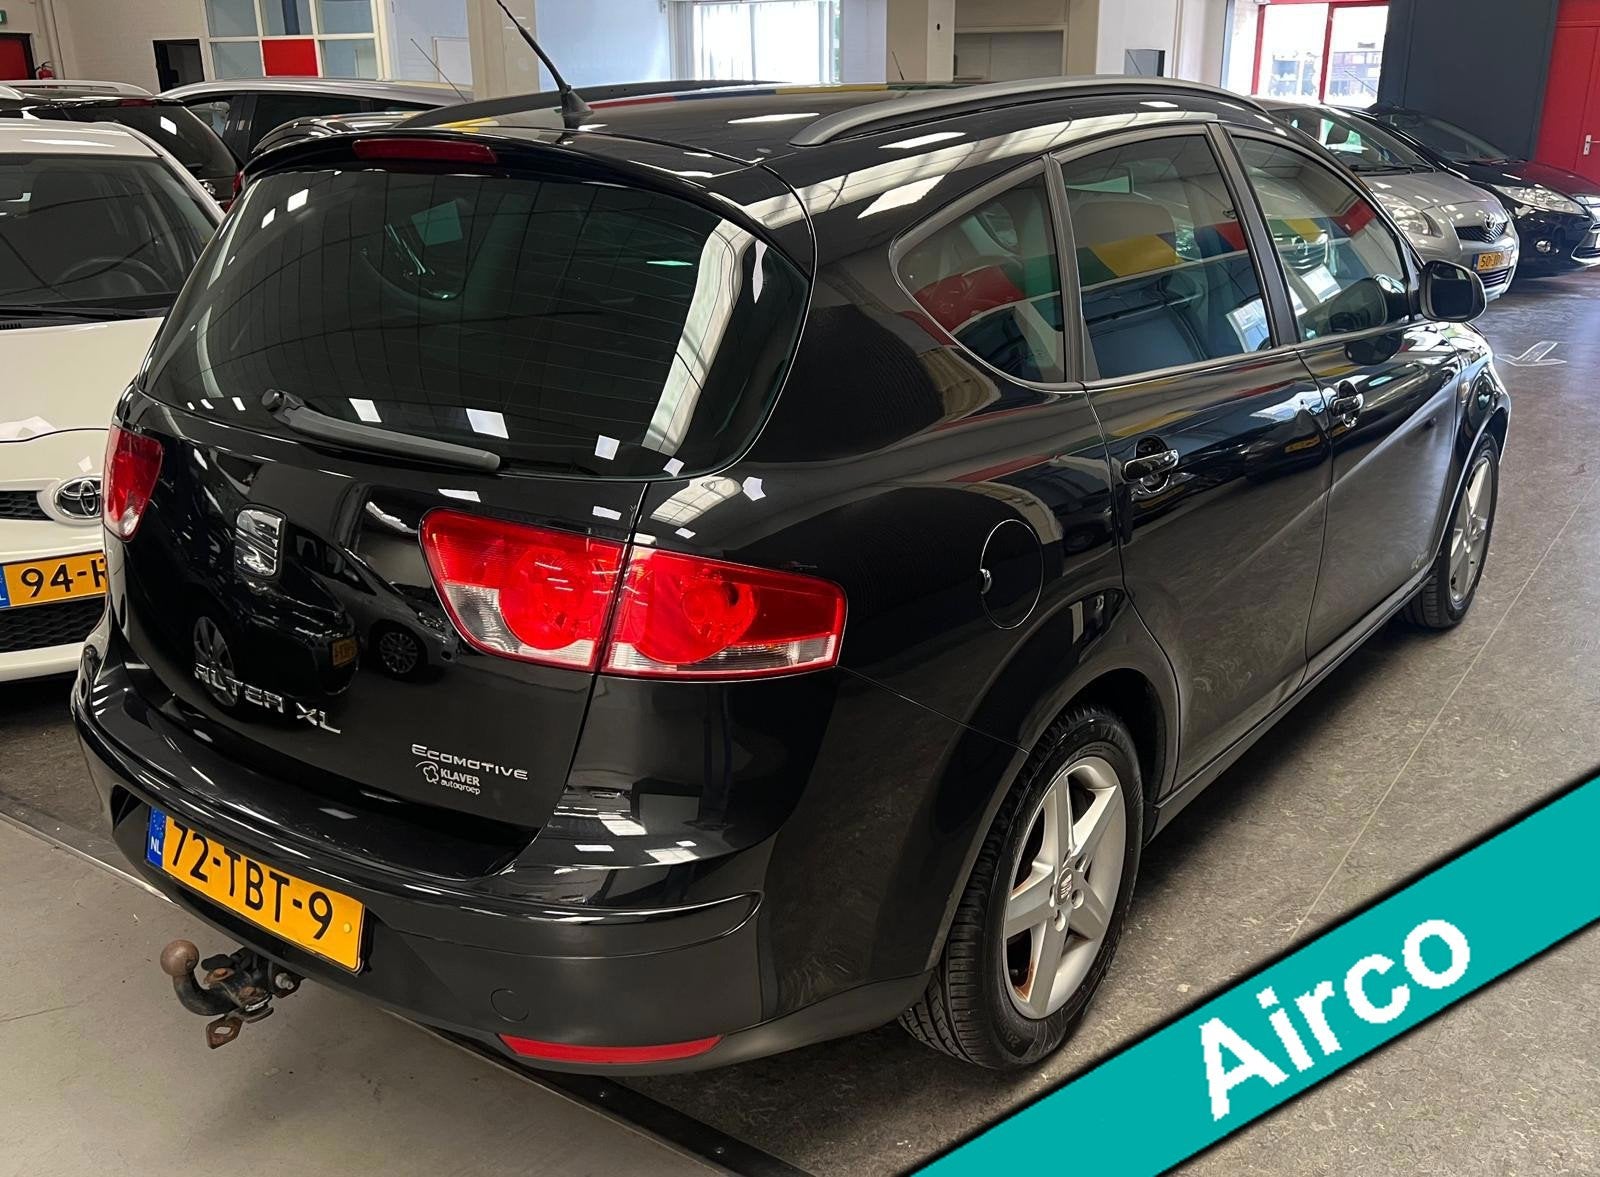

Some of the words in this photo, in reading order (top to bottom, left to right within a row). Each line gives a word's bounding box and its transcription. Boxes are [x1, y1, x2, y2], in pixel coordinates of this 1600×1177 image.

[194, 662, 284, 713] ALTEA
[296, 702, 341, 734] XL
[411, 743, 528, 780] ECOMOTIVE
[440, 768, 480, 787] KLAVER
[440, 779, 481, 795] autogroep
[150, 836, 162, 856] NL
[172, 818, 333, 941] 72-TBT-9
